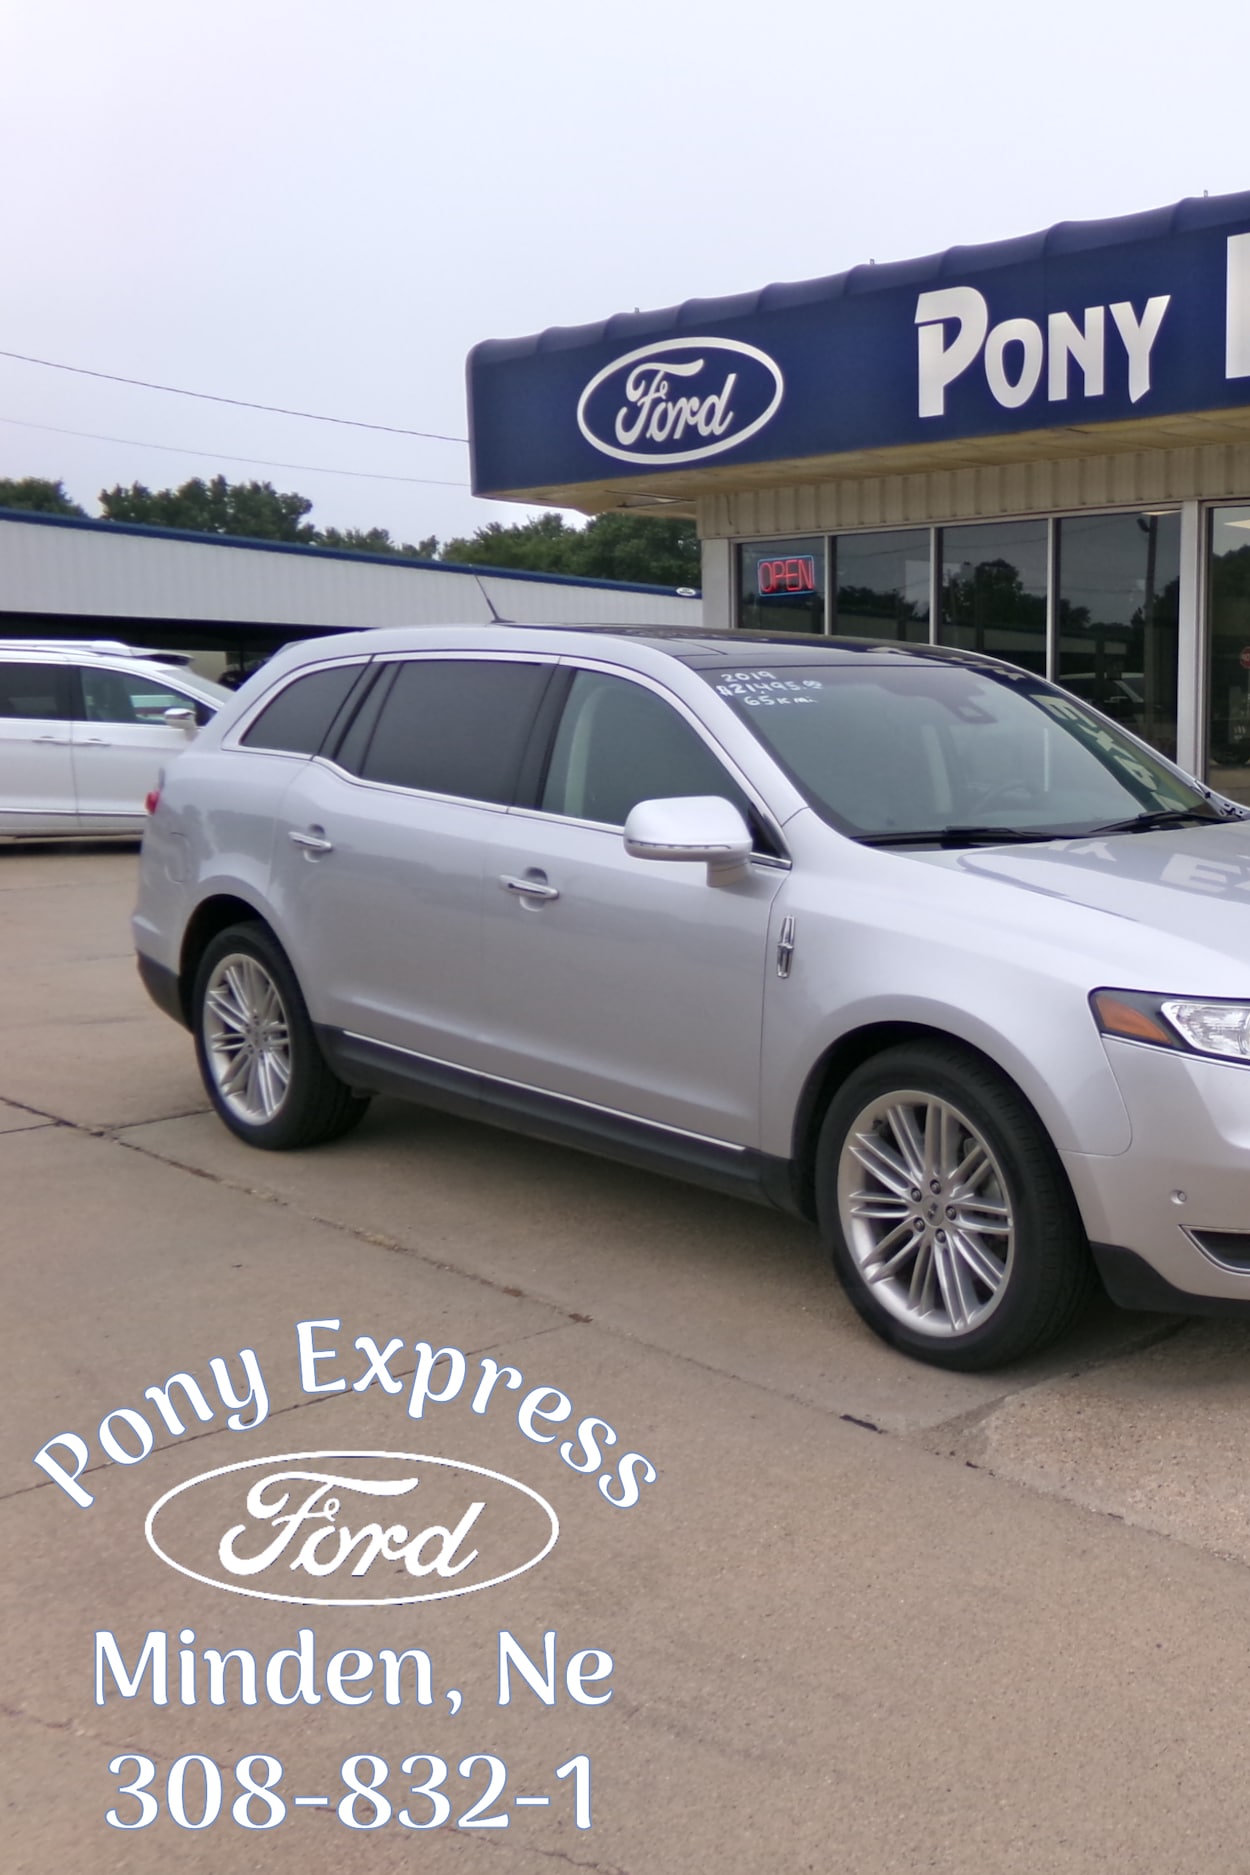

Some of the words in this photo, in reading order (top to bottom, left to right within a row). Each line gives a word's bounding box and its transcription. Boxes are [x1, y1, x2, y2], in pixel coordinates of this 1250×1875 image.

[915, 286, 1171, 418] PONY
[615, 358, 737, 445] Ford
[760, 559, 815, 592] OPEN
[720, 670, 777, 683] 2019
